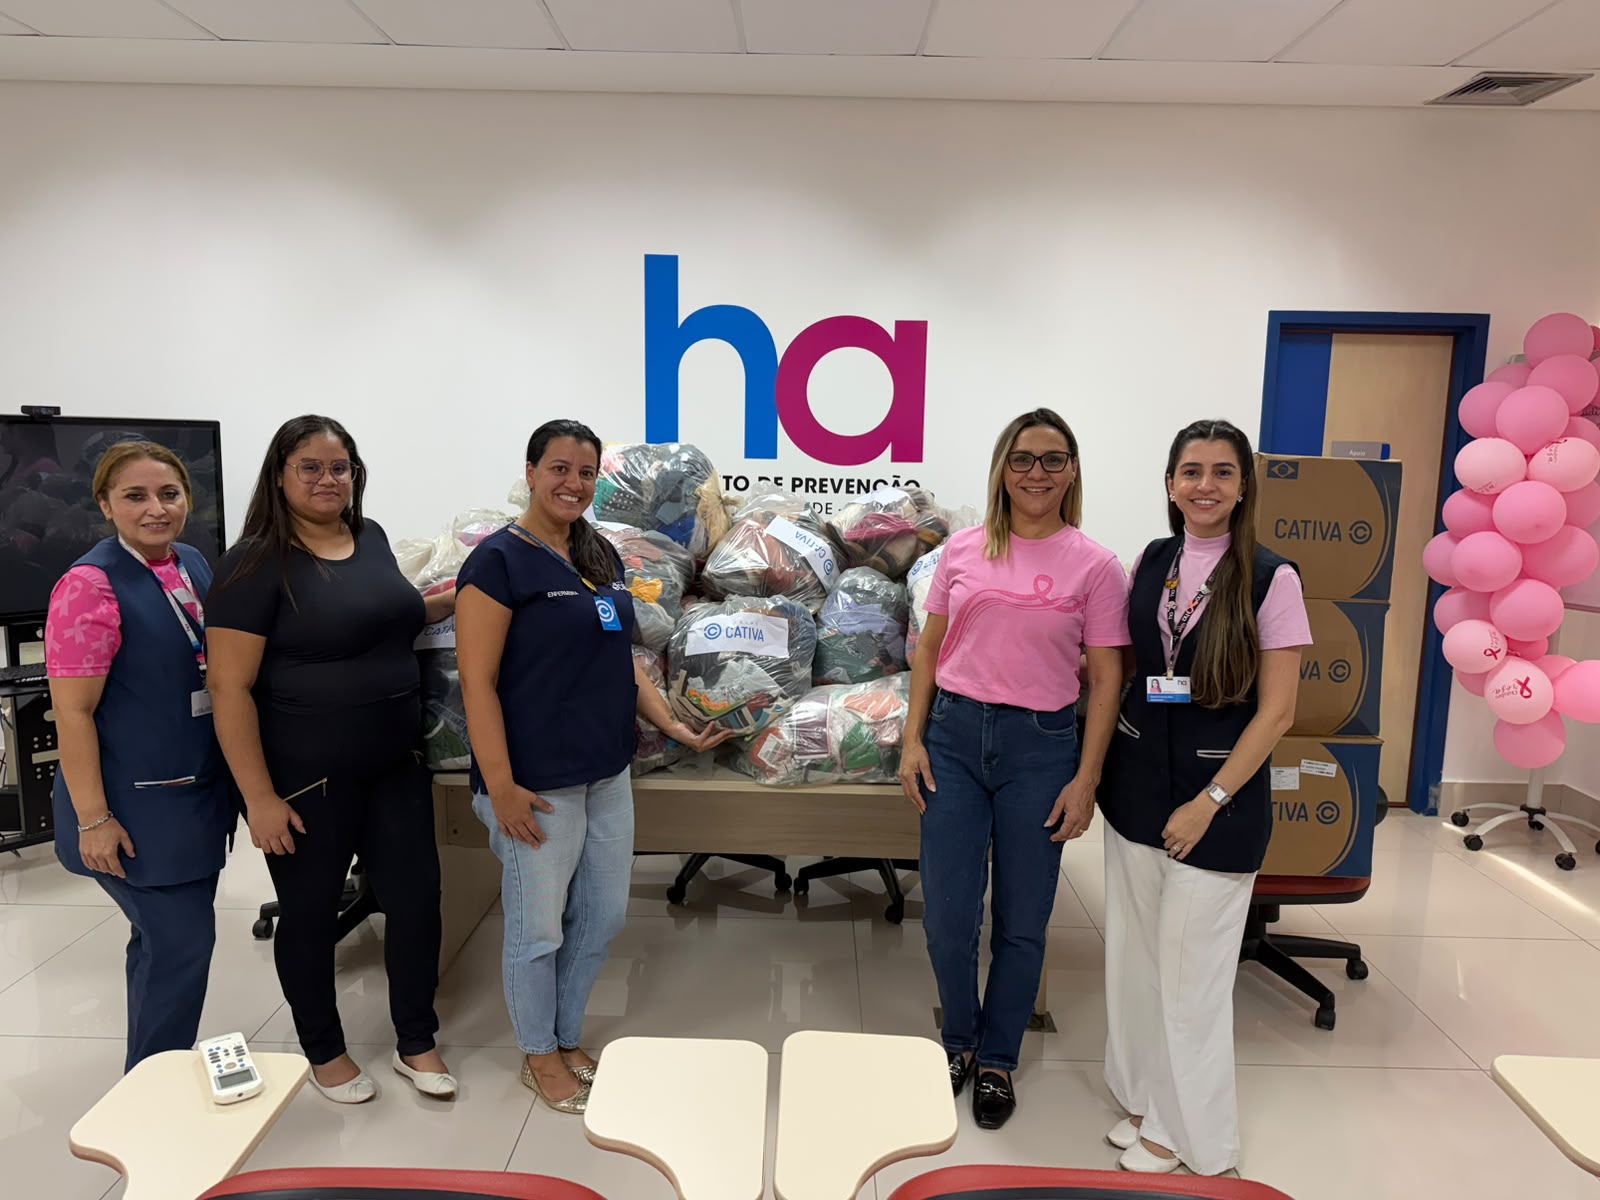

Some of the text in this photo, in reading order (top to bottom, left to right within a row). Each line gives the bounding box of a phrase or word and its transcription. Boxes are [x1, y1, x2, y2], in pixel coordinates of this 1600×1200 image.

[644, 254, 928, 466] ha
[722, 475, 750, 491] TO
[1275, 518, 1341, 542] CATIVA
[424, 623, 455, 636] CATIV
[725, 626, 764, 642] CATIVA
